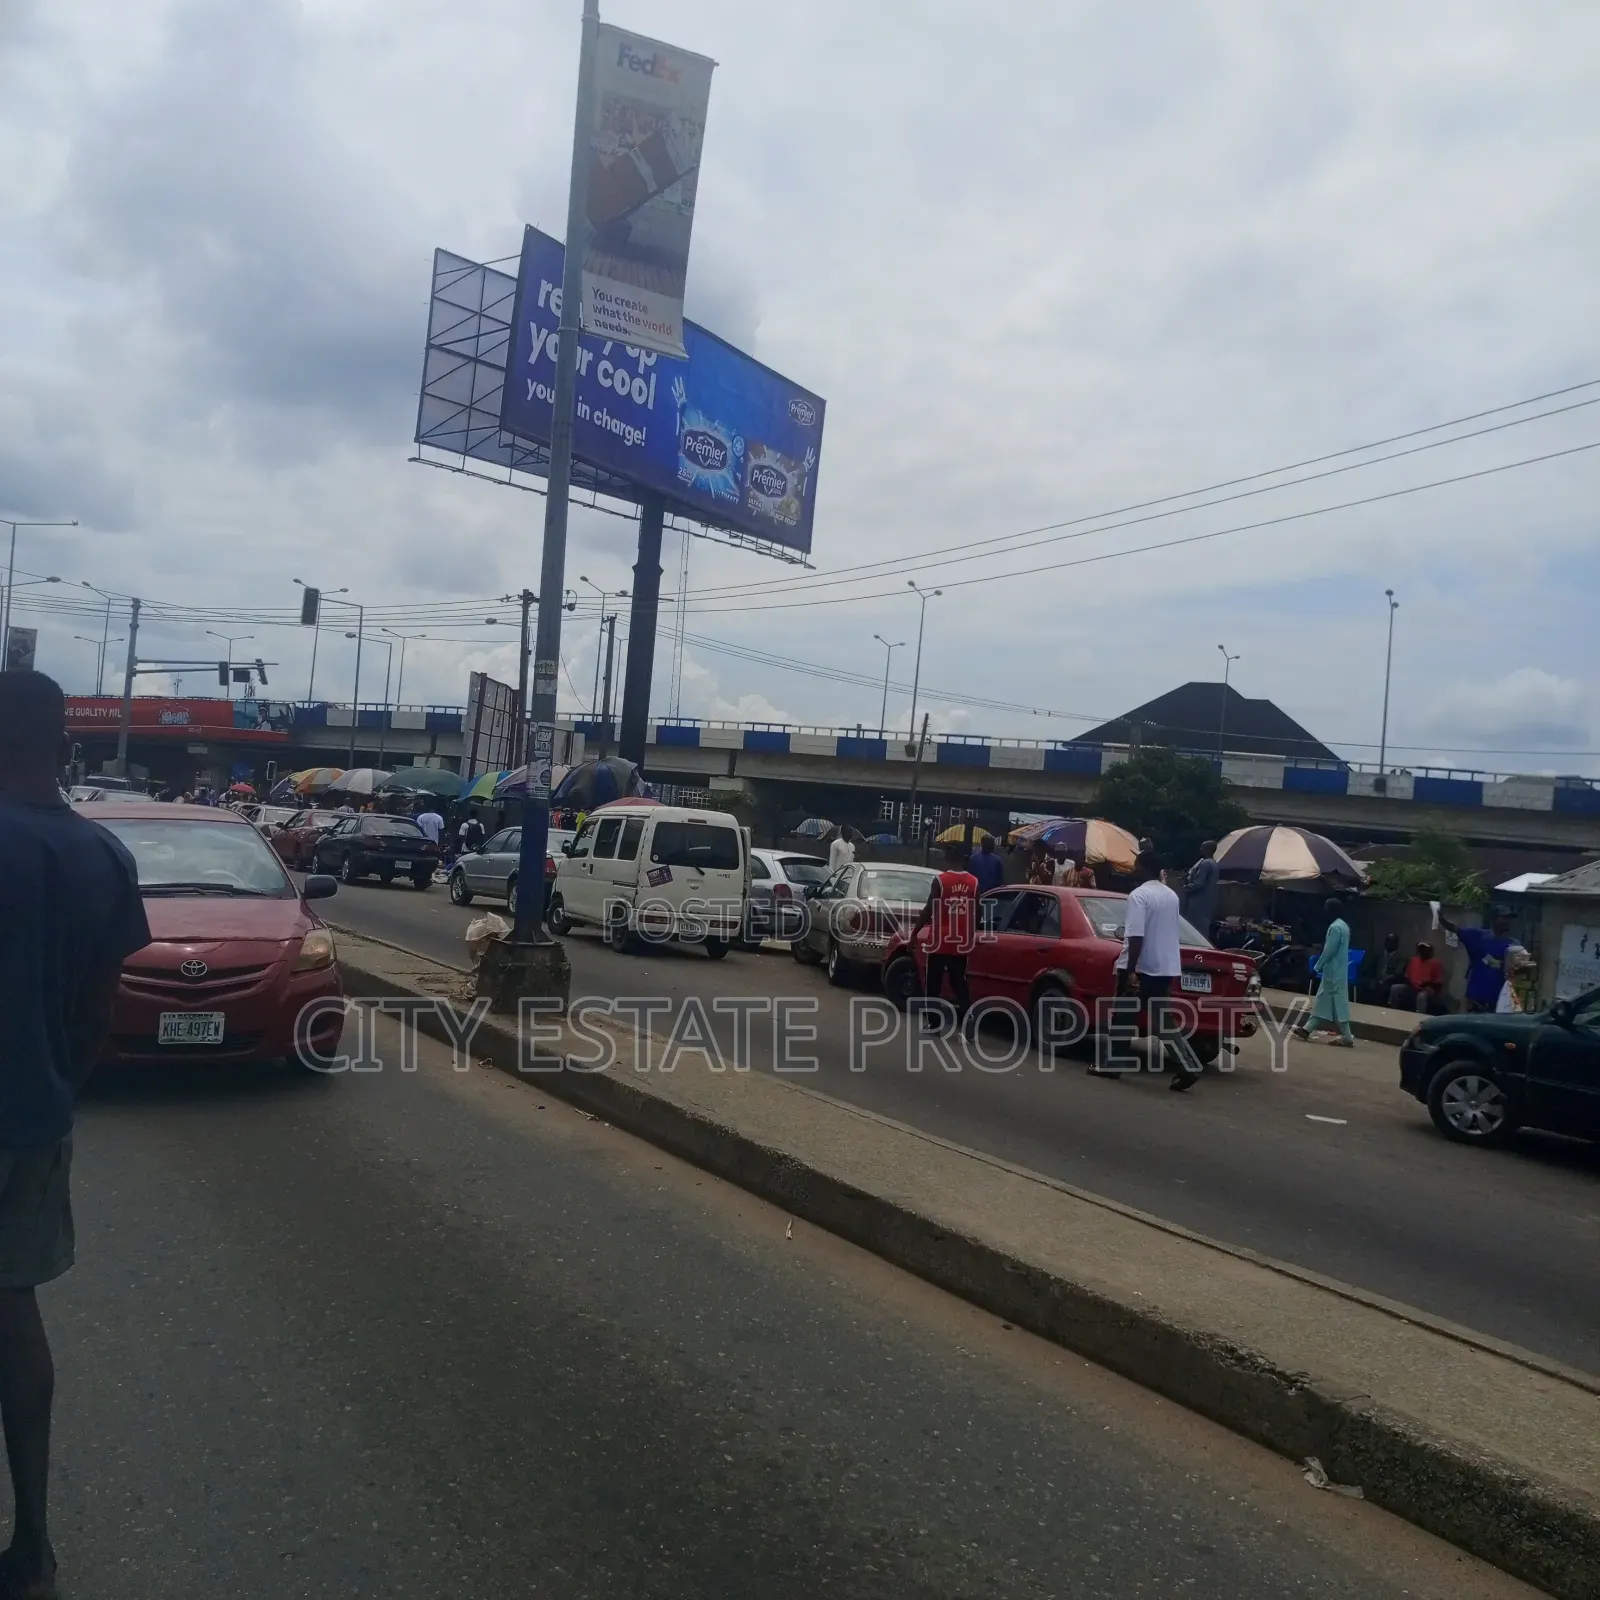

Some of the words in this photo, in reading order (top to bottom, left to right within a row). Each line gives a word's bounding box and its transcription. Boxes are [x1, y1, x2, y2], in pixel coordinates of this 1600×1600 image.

[592, 286, 613, 304] You
[614, 296, 649, 315] create
[593, 303, 622, 321] what
[622, 311, 642, 326] the
[642, 319, 673, 336] world
[527, 320, 594, 377] yor
[596, 359, 657, 411] cool
[576, 395, 590, 421] in
[592, 407, 647, 447] charge!
[790, 402, 813, 419] Premier
[684, 435, 726, 461] Premier
[752, 469, 786, 491] Premier
[75, 707, 107, 718] QUALITY
[108, 708, 122, 718] MIL
[951, 883, 969, 894] JAMES
